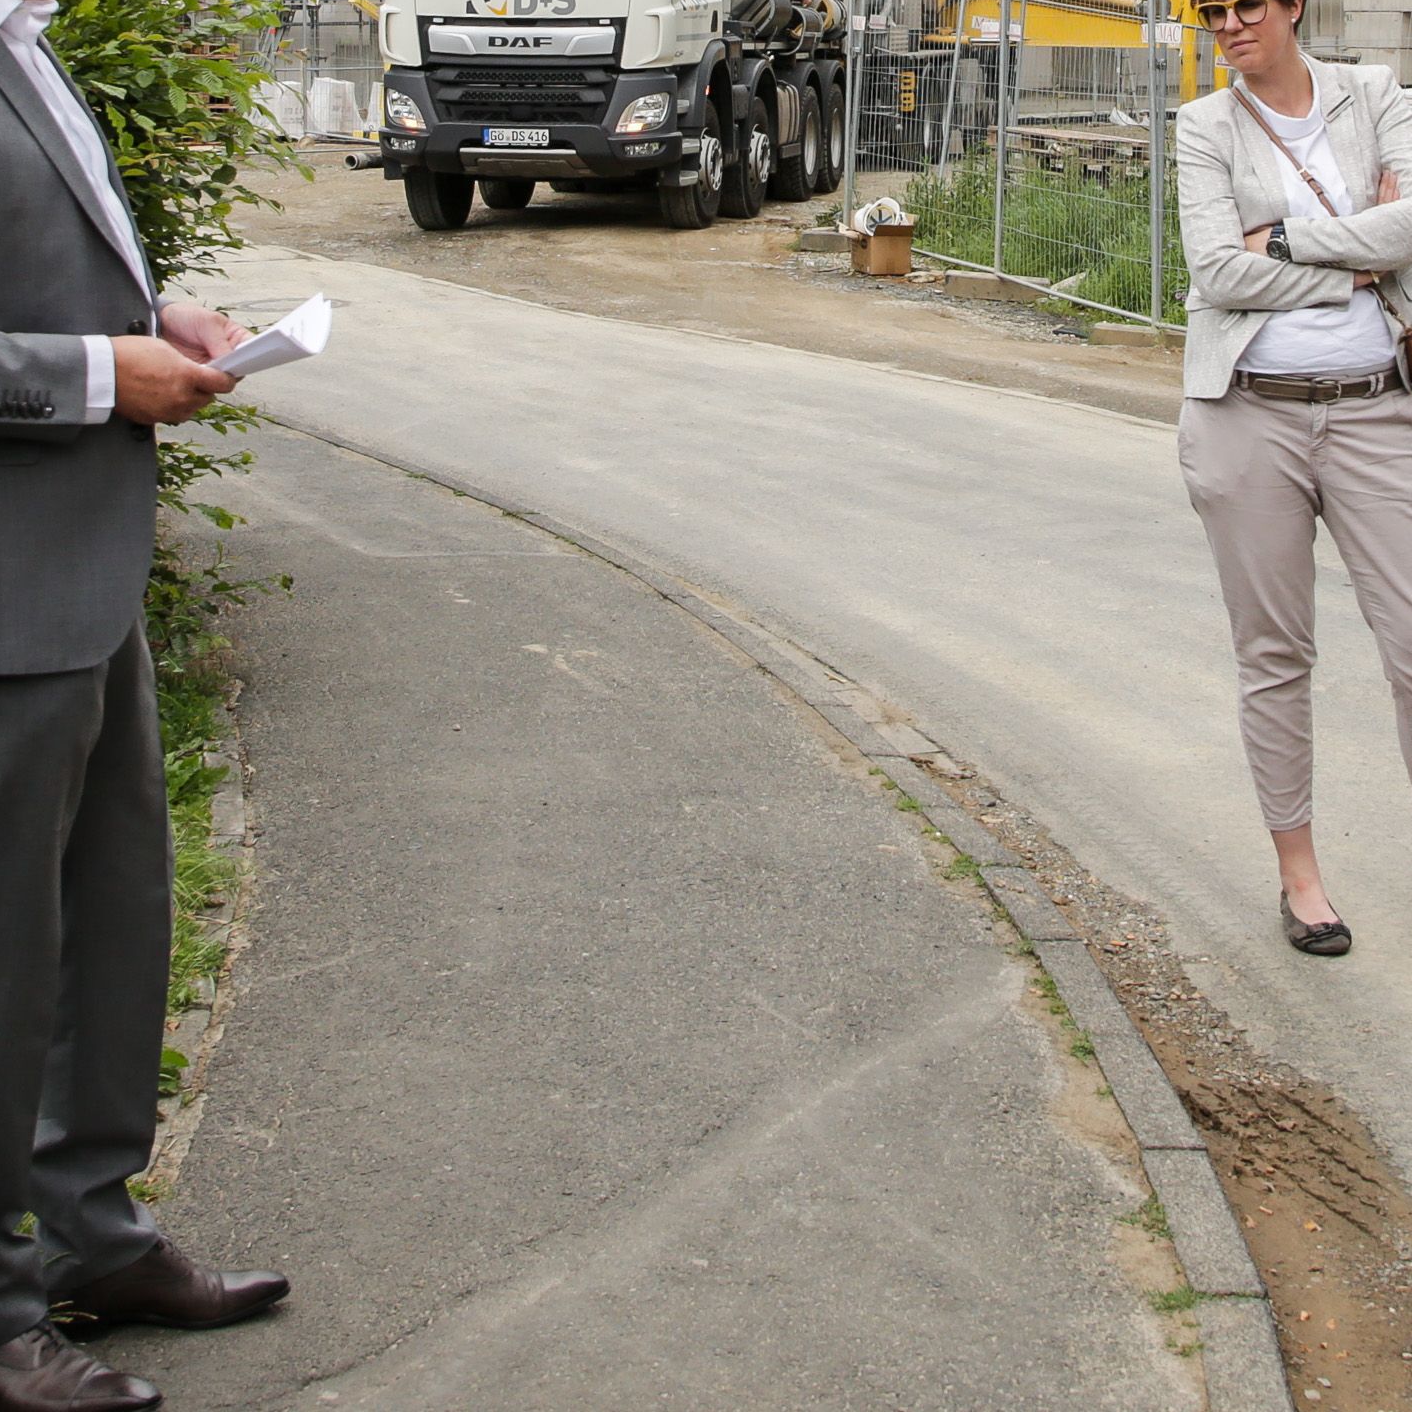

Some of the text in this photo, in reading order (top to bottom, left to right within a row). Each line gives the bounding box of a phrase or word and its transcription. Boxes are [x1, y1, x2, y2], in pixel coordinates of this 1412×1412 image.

[488, 36, 553, 48] DAF
[490, 130, 548, 142] GÖ DS 416
